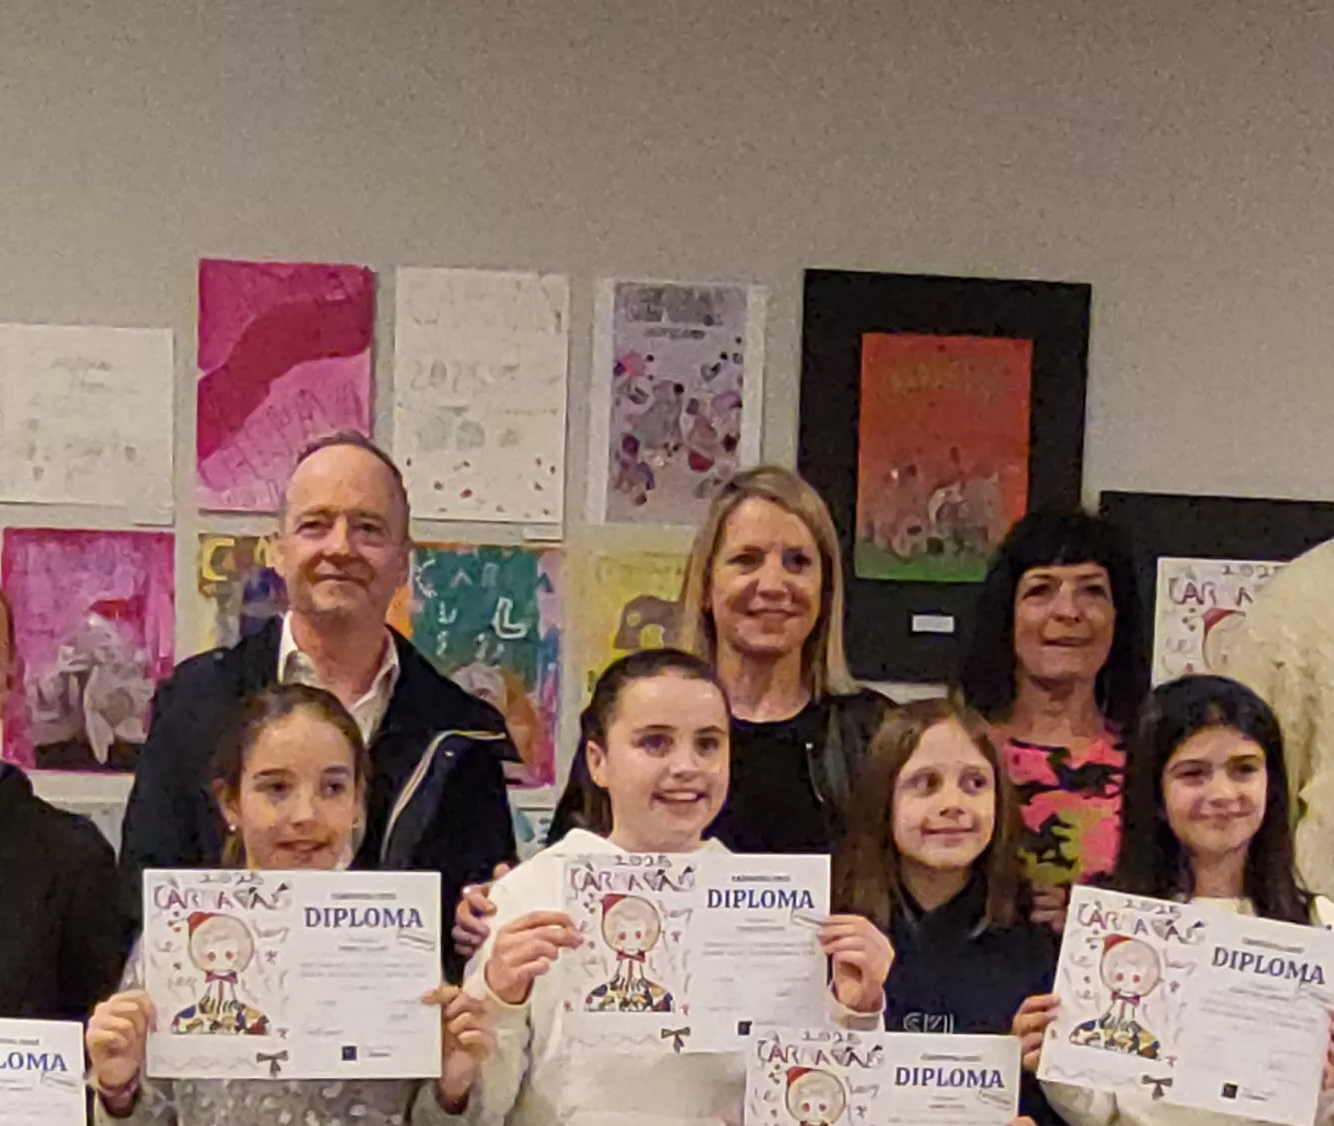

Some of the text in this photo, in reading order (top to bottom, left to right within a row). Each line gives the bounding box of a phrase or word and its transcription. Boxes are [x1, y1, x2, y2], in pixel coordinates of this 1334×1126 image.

[707, 889, 815, 910] DIPLOMA
[304, 907, 424, 929] DIPLOMA
[1211, 946, 1325, 986] DIPLOMA
[895, 1066, 1005, 1089] DIPLOMA
